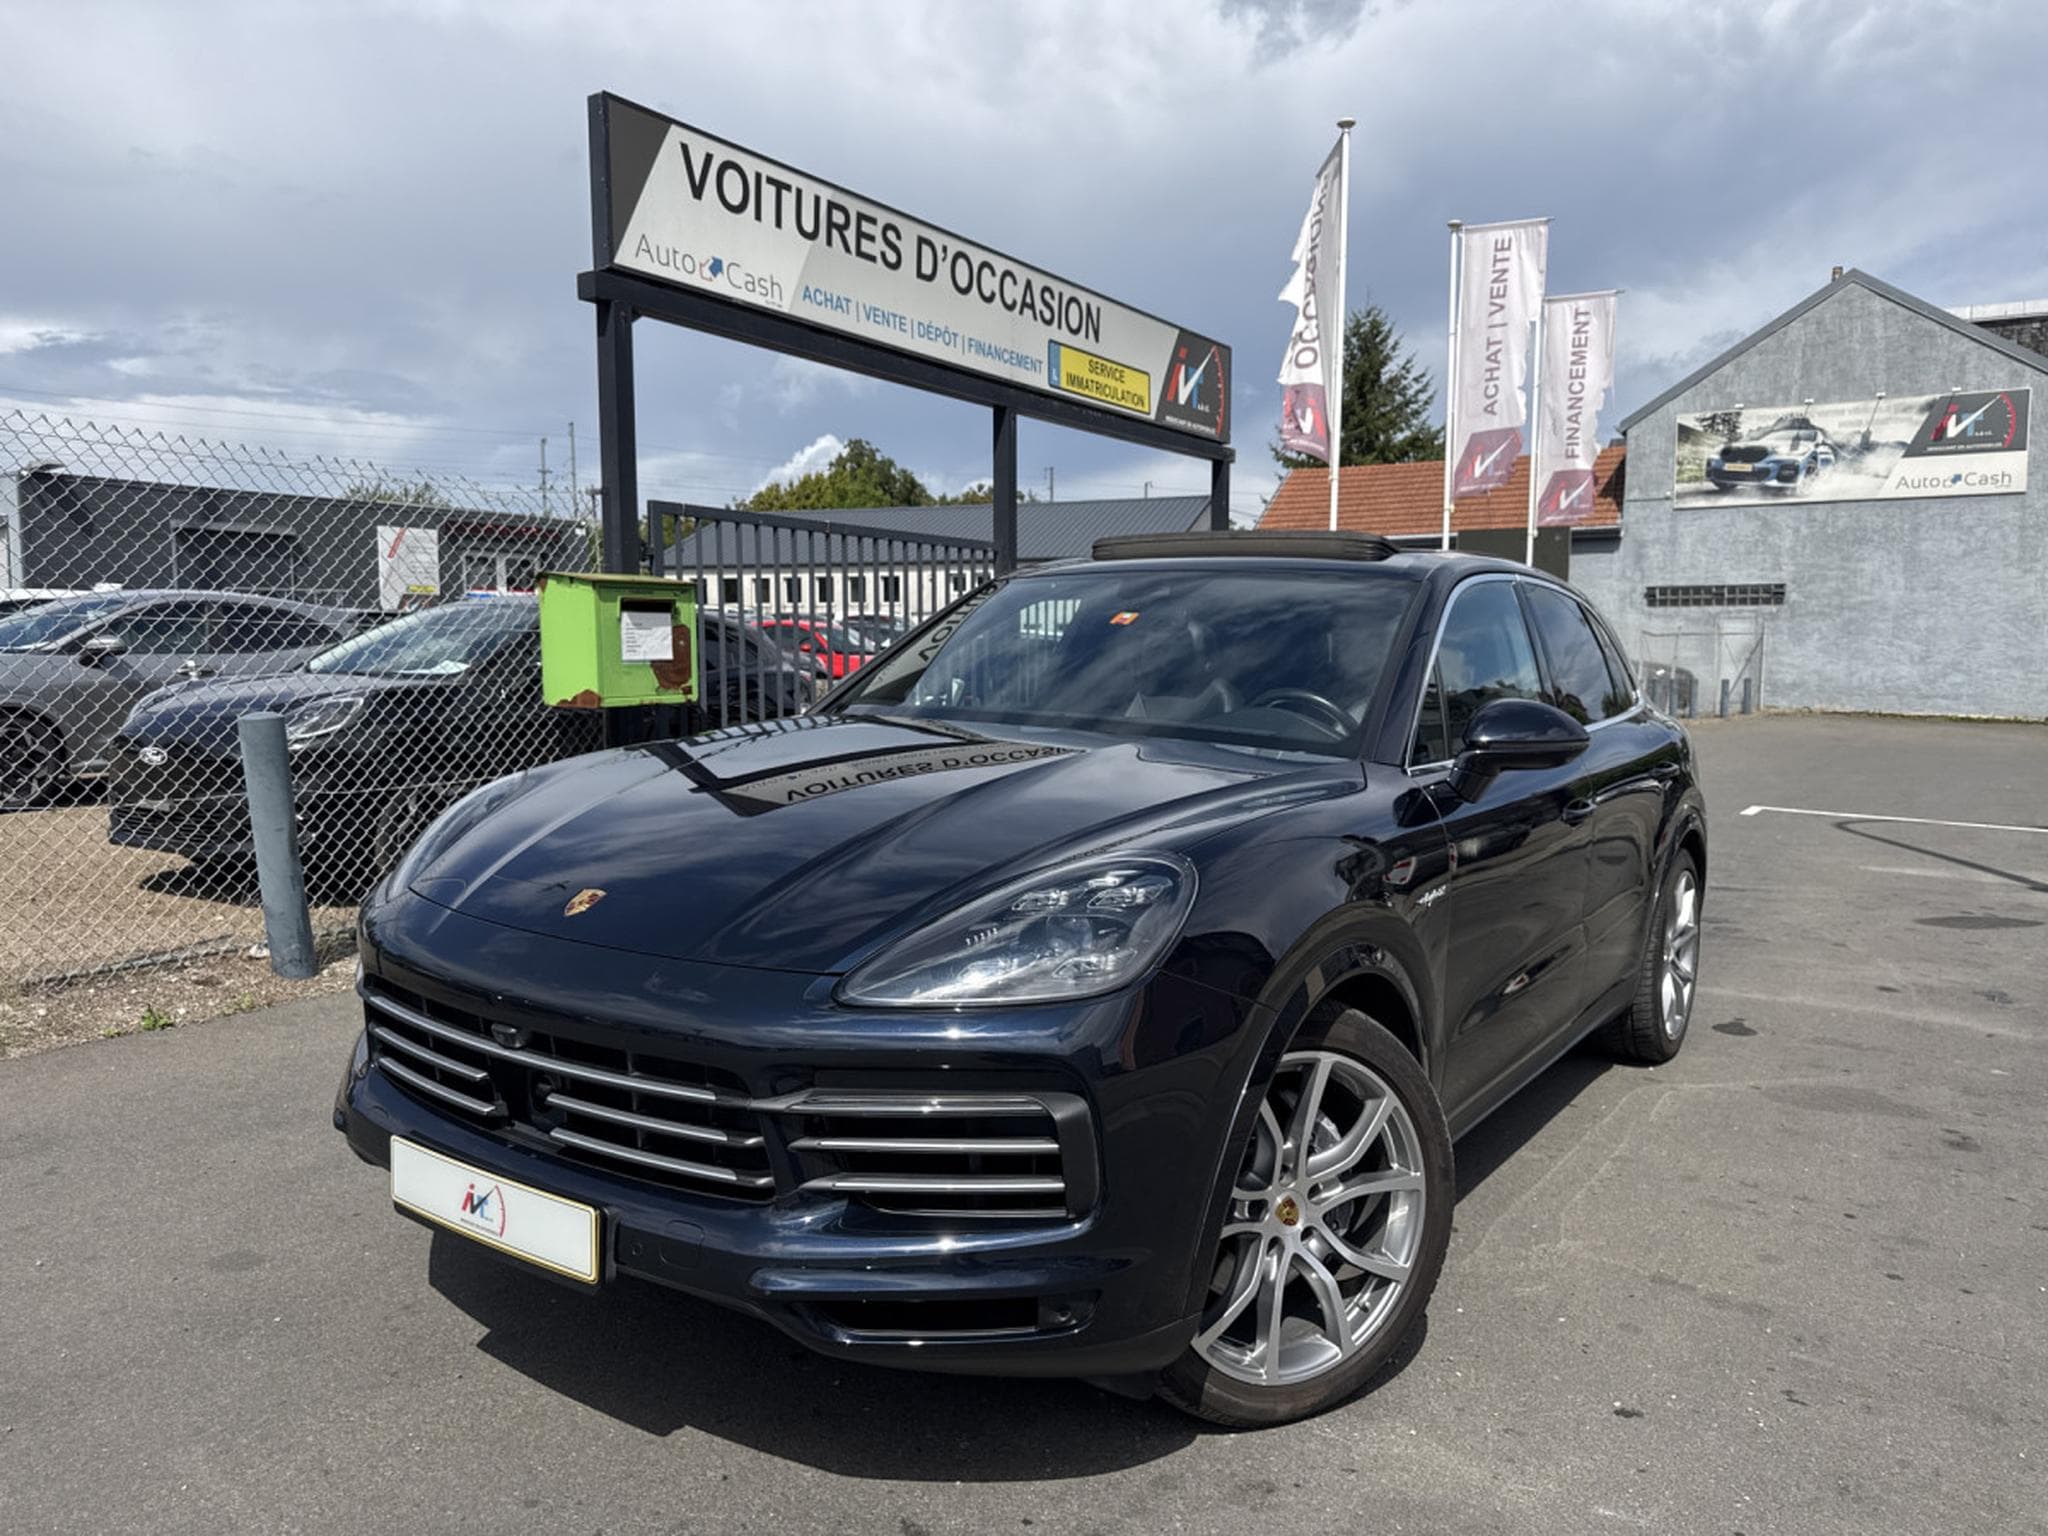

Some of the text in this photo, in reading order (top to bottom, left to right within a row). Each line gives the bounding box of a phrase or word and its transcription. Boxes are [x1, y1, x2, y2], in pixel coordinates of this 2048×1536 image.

[635, 233, 783, 302] Auto Cash
[679, 141, 1101, 344] VOITURES D'OCCASION
[802, 285, 1044, 374] ACHAT VENTE DÉPÔT FINANCEMENT
[1483, 236, 1512, 417] ACHAT VENTE
[1065, 371, 1145, 408] IMMATRICULATION
[1088, 358, 1126, 384] SERVICE
[1565, 306, 1592, 460] FINANCEMENT
[1895, 470, 2013, 490] Auto Cash
